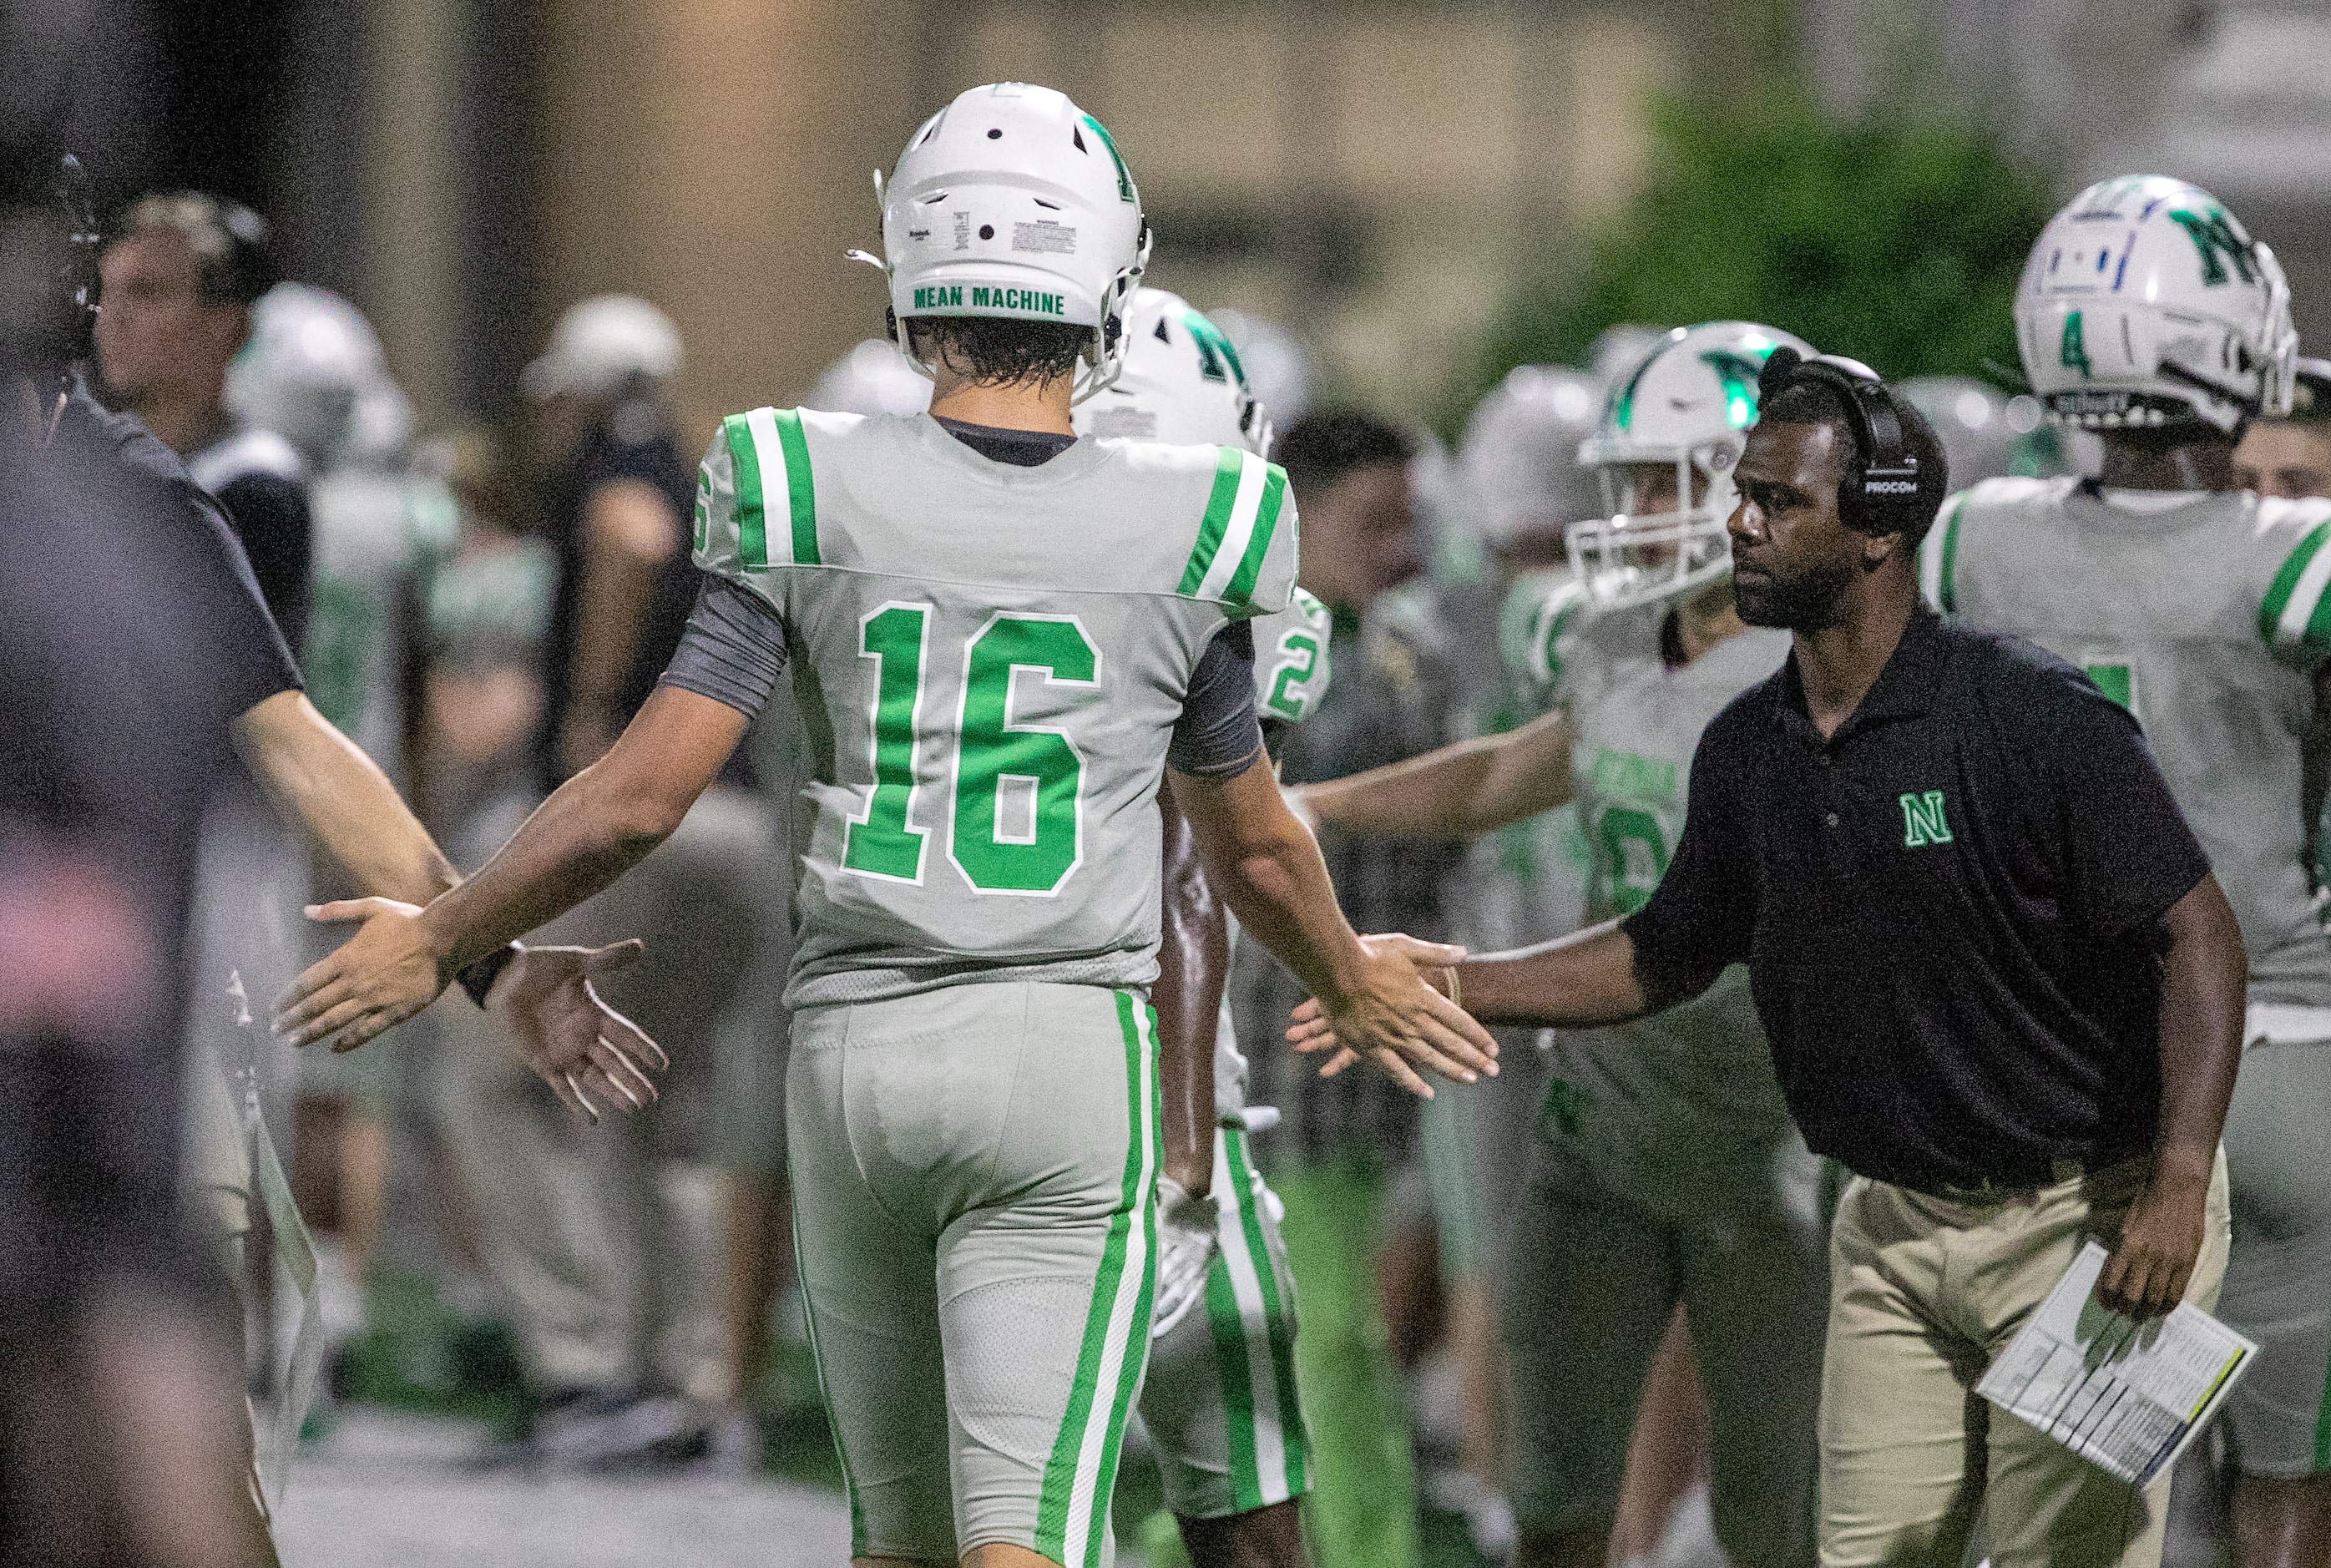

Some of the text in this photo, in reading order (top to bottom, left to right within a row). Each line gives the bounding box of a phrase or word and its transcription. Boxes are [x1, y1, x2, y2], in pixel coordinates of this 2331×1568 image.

[914, 286, 1064, 315] MEAN MACHINE
[1864, 481, 1918, 494] PROCOM
[839, 600, 1103, 898] 16
[1899, 790, 1953, 847] N
